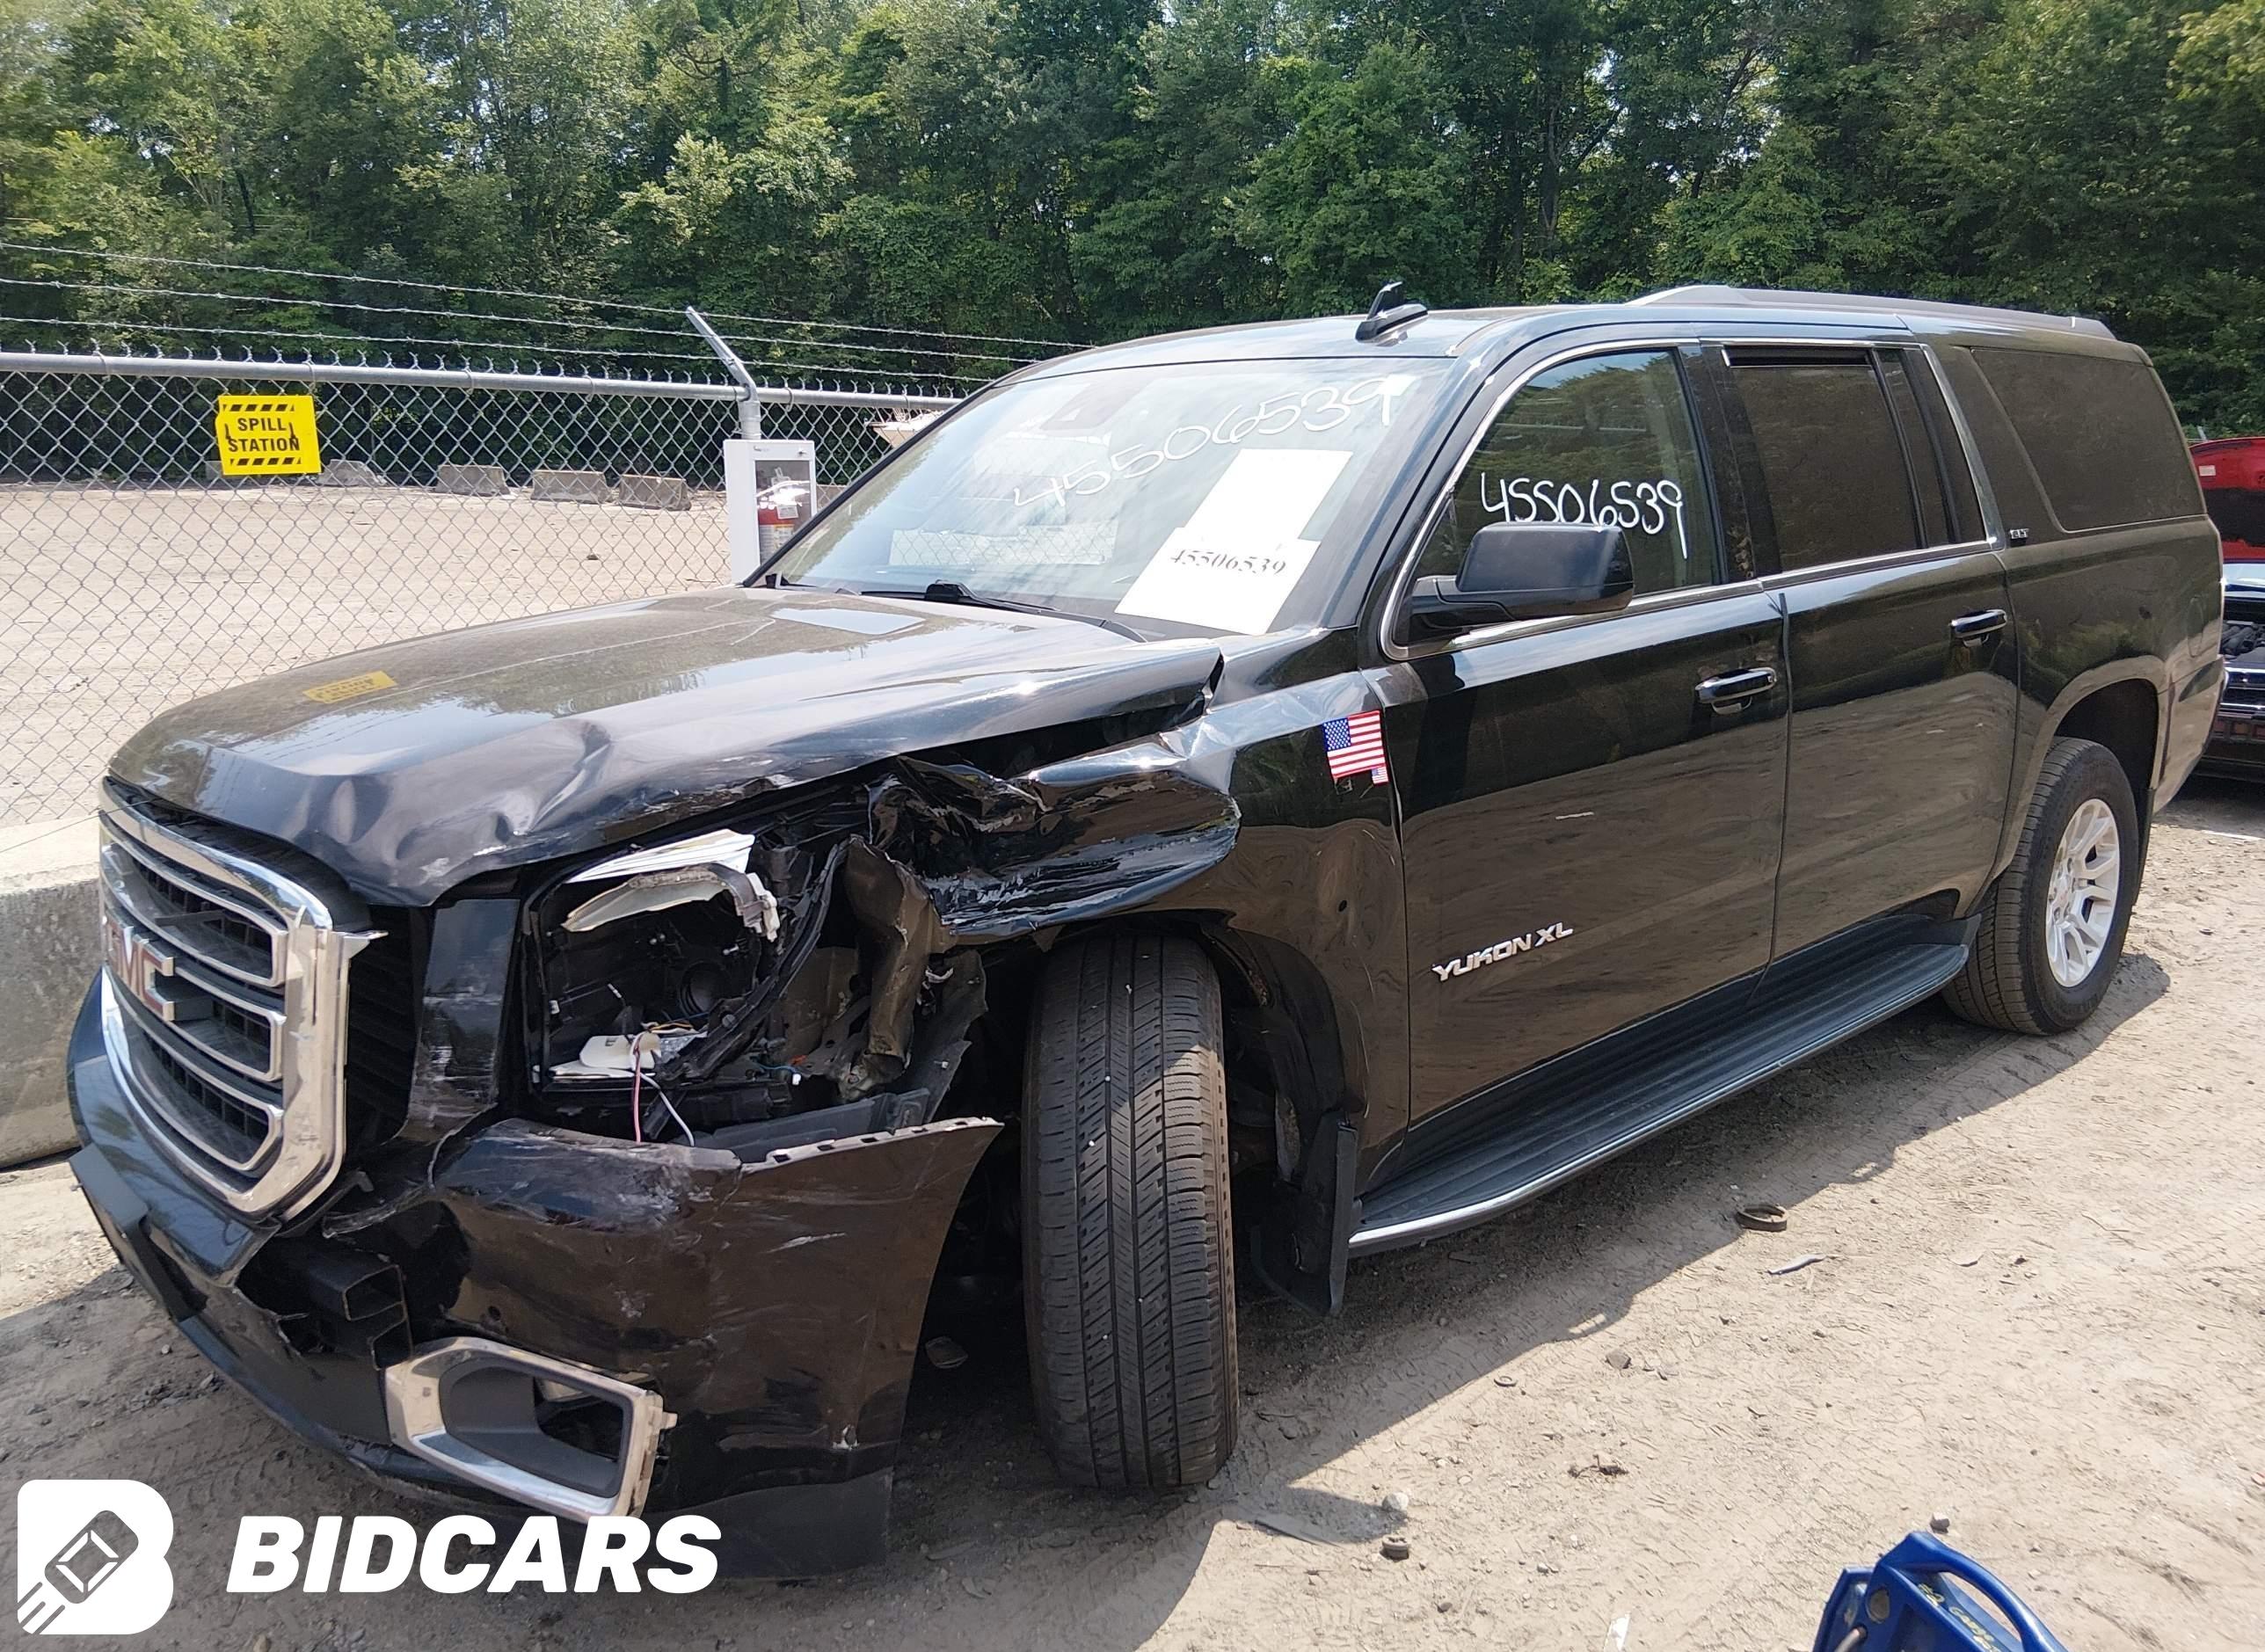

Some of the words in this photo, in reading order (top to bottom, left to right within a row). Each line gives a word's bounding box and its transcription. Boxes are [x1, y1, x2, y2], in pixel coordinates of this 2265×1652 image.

[229, 438, 300, 452] STATION
[237, 418, 287, 432] SPILL
[1014, 377, 1416, 506] 45506539
[1481, 472, 1687, 559] 45506539
[1170, 549, 1287, 575] 45506539
[1431, 934, 1532, 981] YUKON
[1534, 922, 1573, 947] XL
